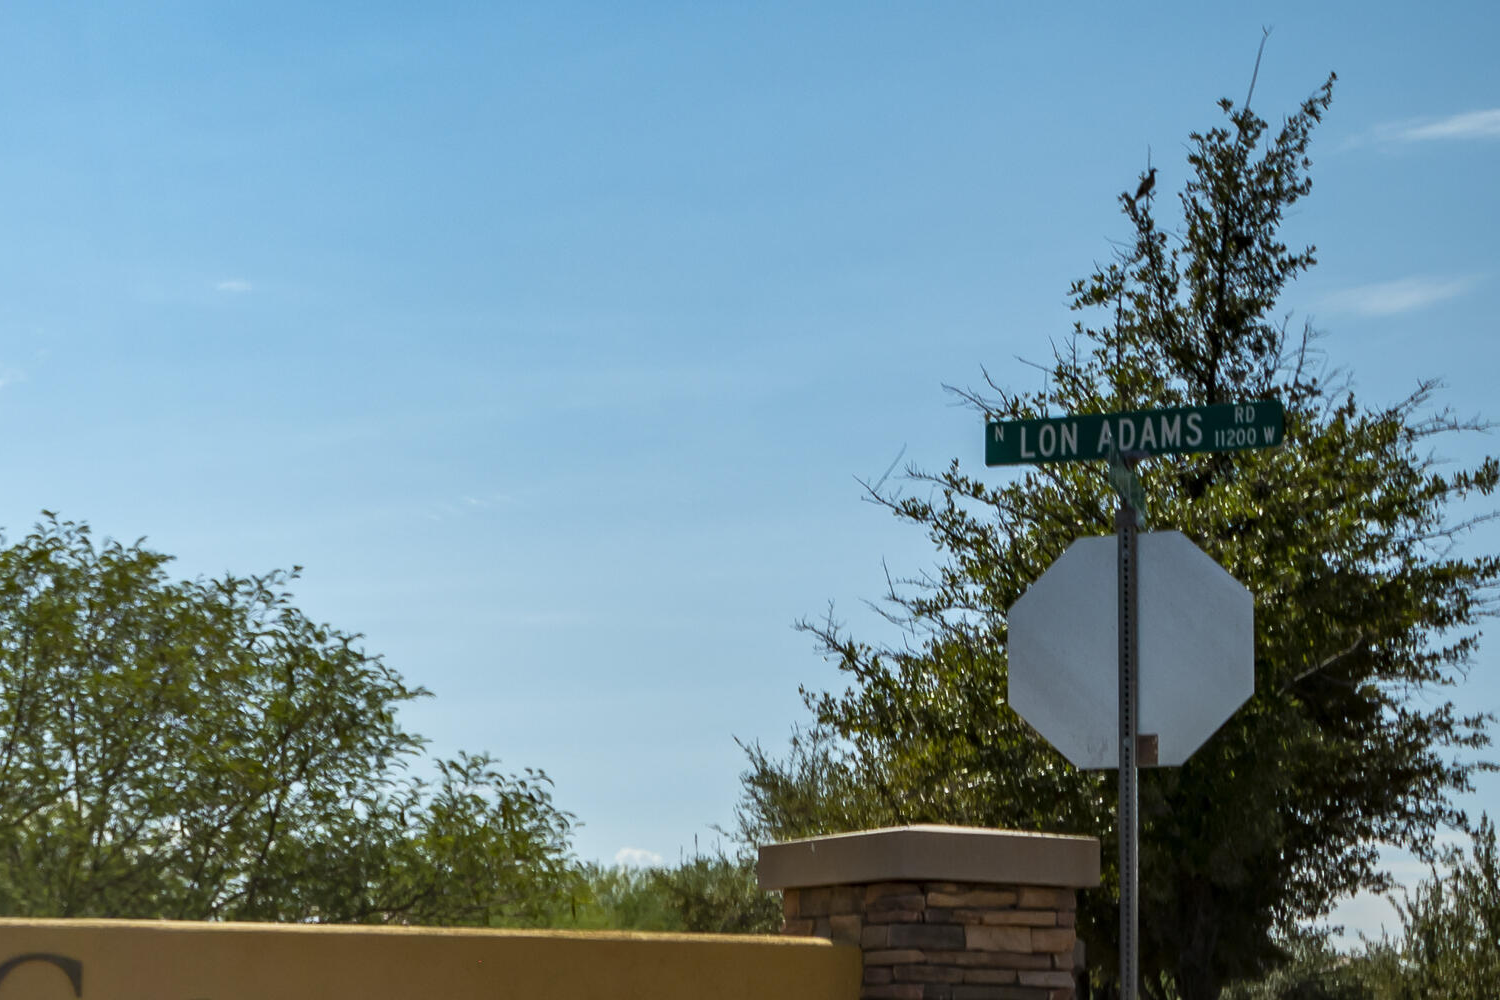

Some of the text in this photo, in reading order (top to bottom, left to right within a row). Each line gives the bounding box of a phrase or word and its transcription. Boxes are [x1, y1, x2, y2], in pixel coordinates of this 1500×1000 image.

[1234, 405, 1256, 424] RD
[995, 413, 1203, 459] N LON ADAMS
[1214, 425, 1275, 448] 11200 W
